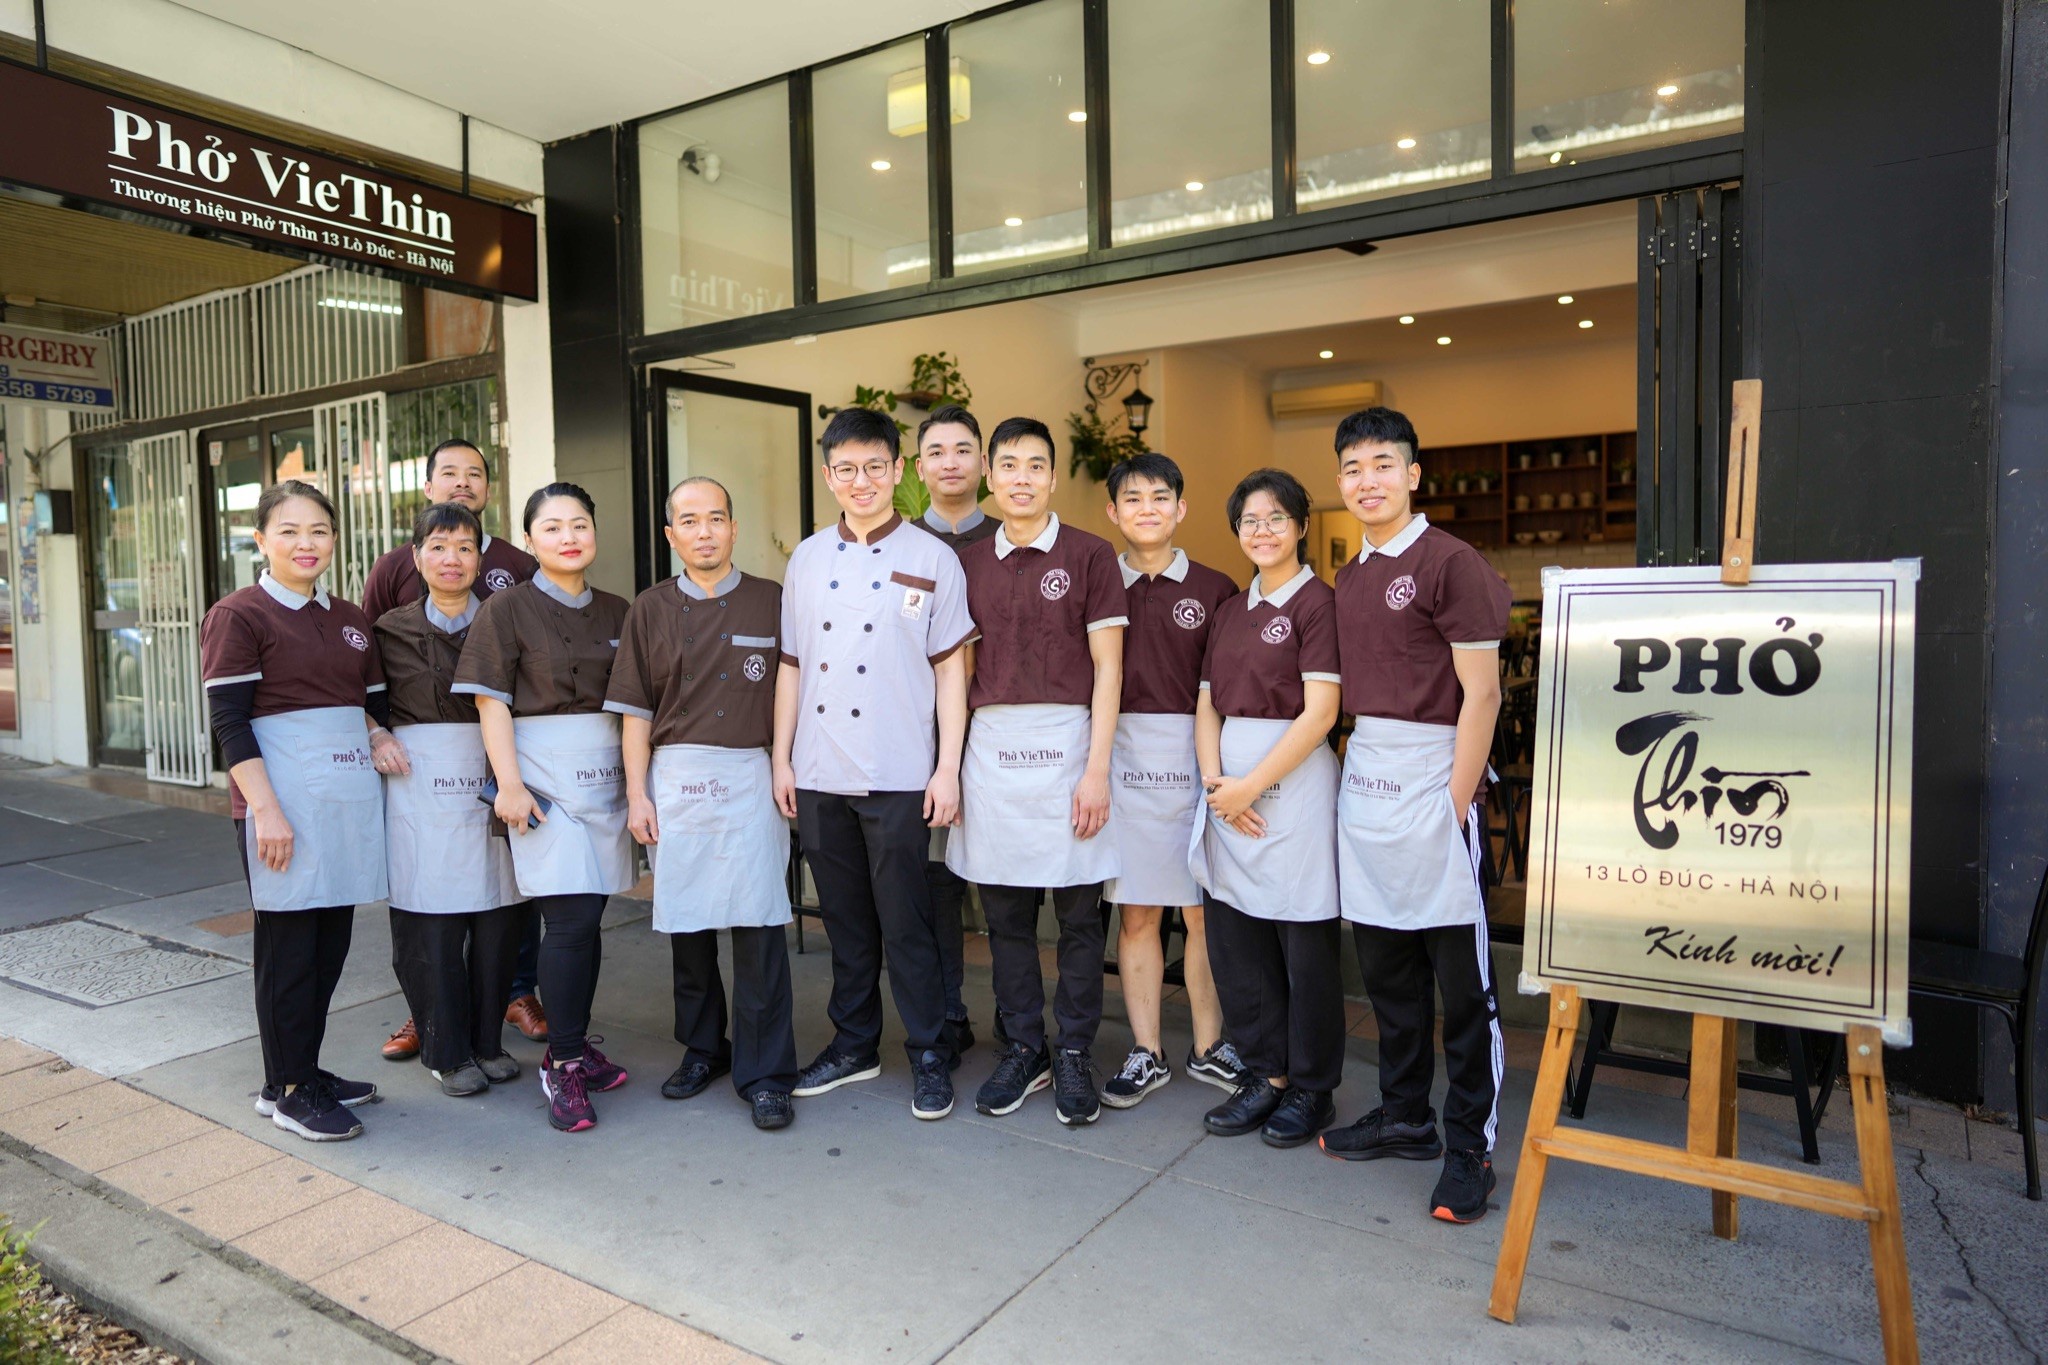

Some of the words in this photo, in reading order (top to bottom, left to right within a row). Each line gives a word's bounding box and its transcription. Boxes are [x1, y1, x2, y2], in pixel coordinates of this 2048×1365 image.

[106, 105, 238, 183] Phở
[250, 147, 454, 243] VieThin
[110, 178, 192, 215] Thương
[195, 198, 237, 222] hiệu
[241, 210, 276, 231] Phở
[279, 219, 318, 242] Thìn
[321, 230, 340, 247] 13
[343, 235, 363, 252] Lò
[365, 241, 396, 260] Đúc
[406, 250, 427, 268] Hà
[430, 256, 455, 275] Nội
[46, 385, 97, 404] 5799
[1613, 616, 1824, 697] PHỞ
[333, 750, 356, 763] PHỞ
[998, 750, 1018, 762] Phở
[1020, 749, 1064, 761] VieThin
[434, 777, 456, 788] Phở
[1123, 771, 1144, 782] Phở
[1147, 771, 1191, 783] VieThin
[1361, 775, 1402, 793] VieThin
[681, 782, 707, 795] PHỞ
[1714, 821, 1783, 849] 1979
[1585, 865, 1609, 880] 13
[1618, 864, 1648, 884] LÒ
[1659, 868, 1714, 890] ĐÚC
[1740, 875, 1775, 896] HÀ
[1789, 879, 1839, 904] NỘI
[1645, 925, 1738, 965] Kính
[1751, 944, 1845, 977] mời!
